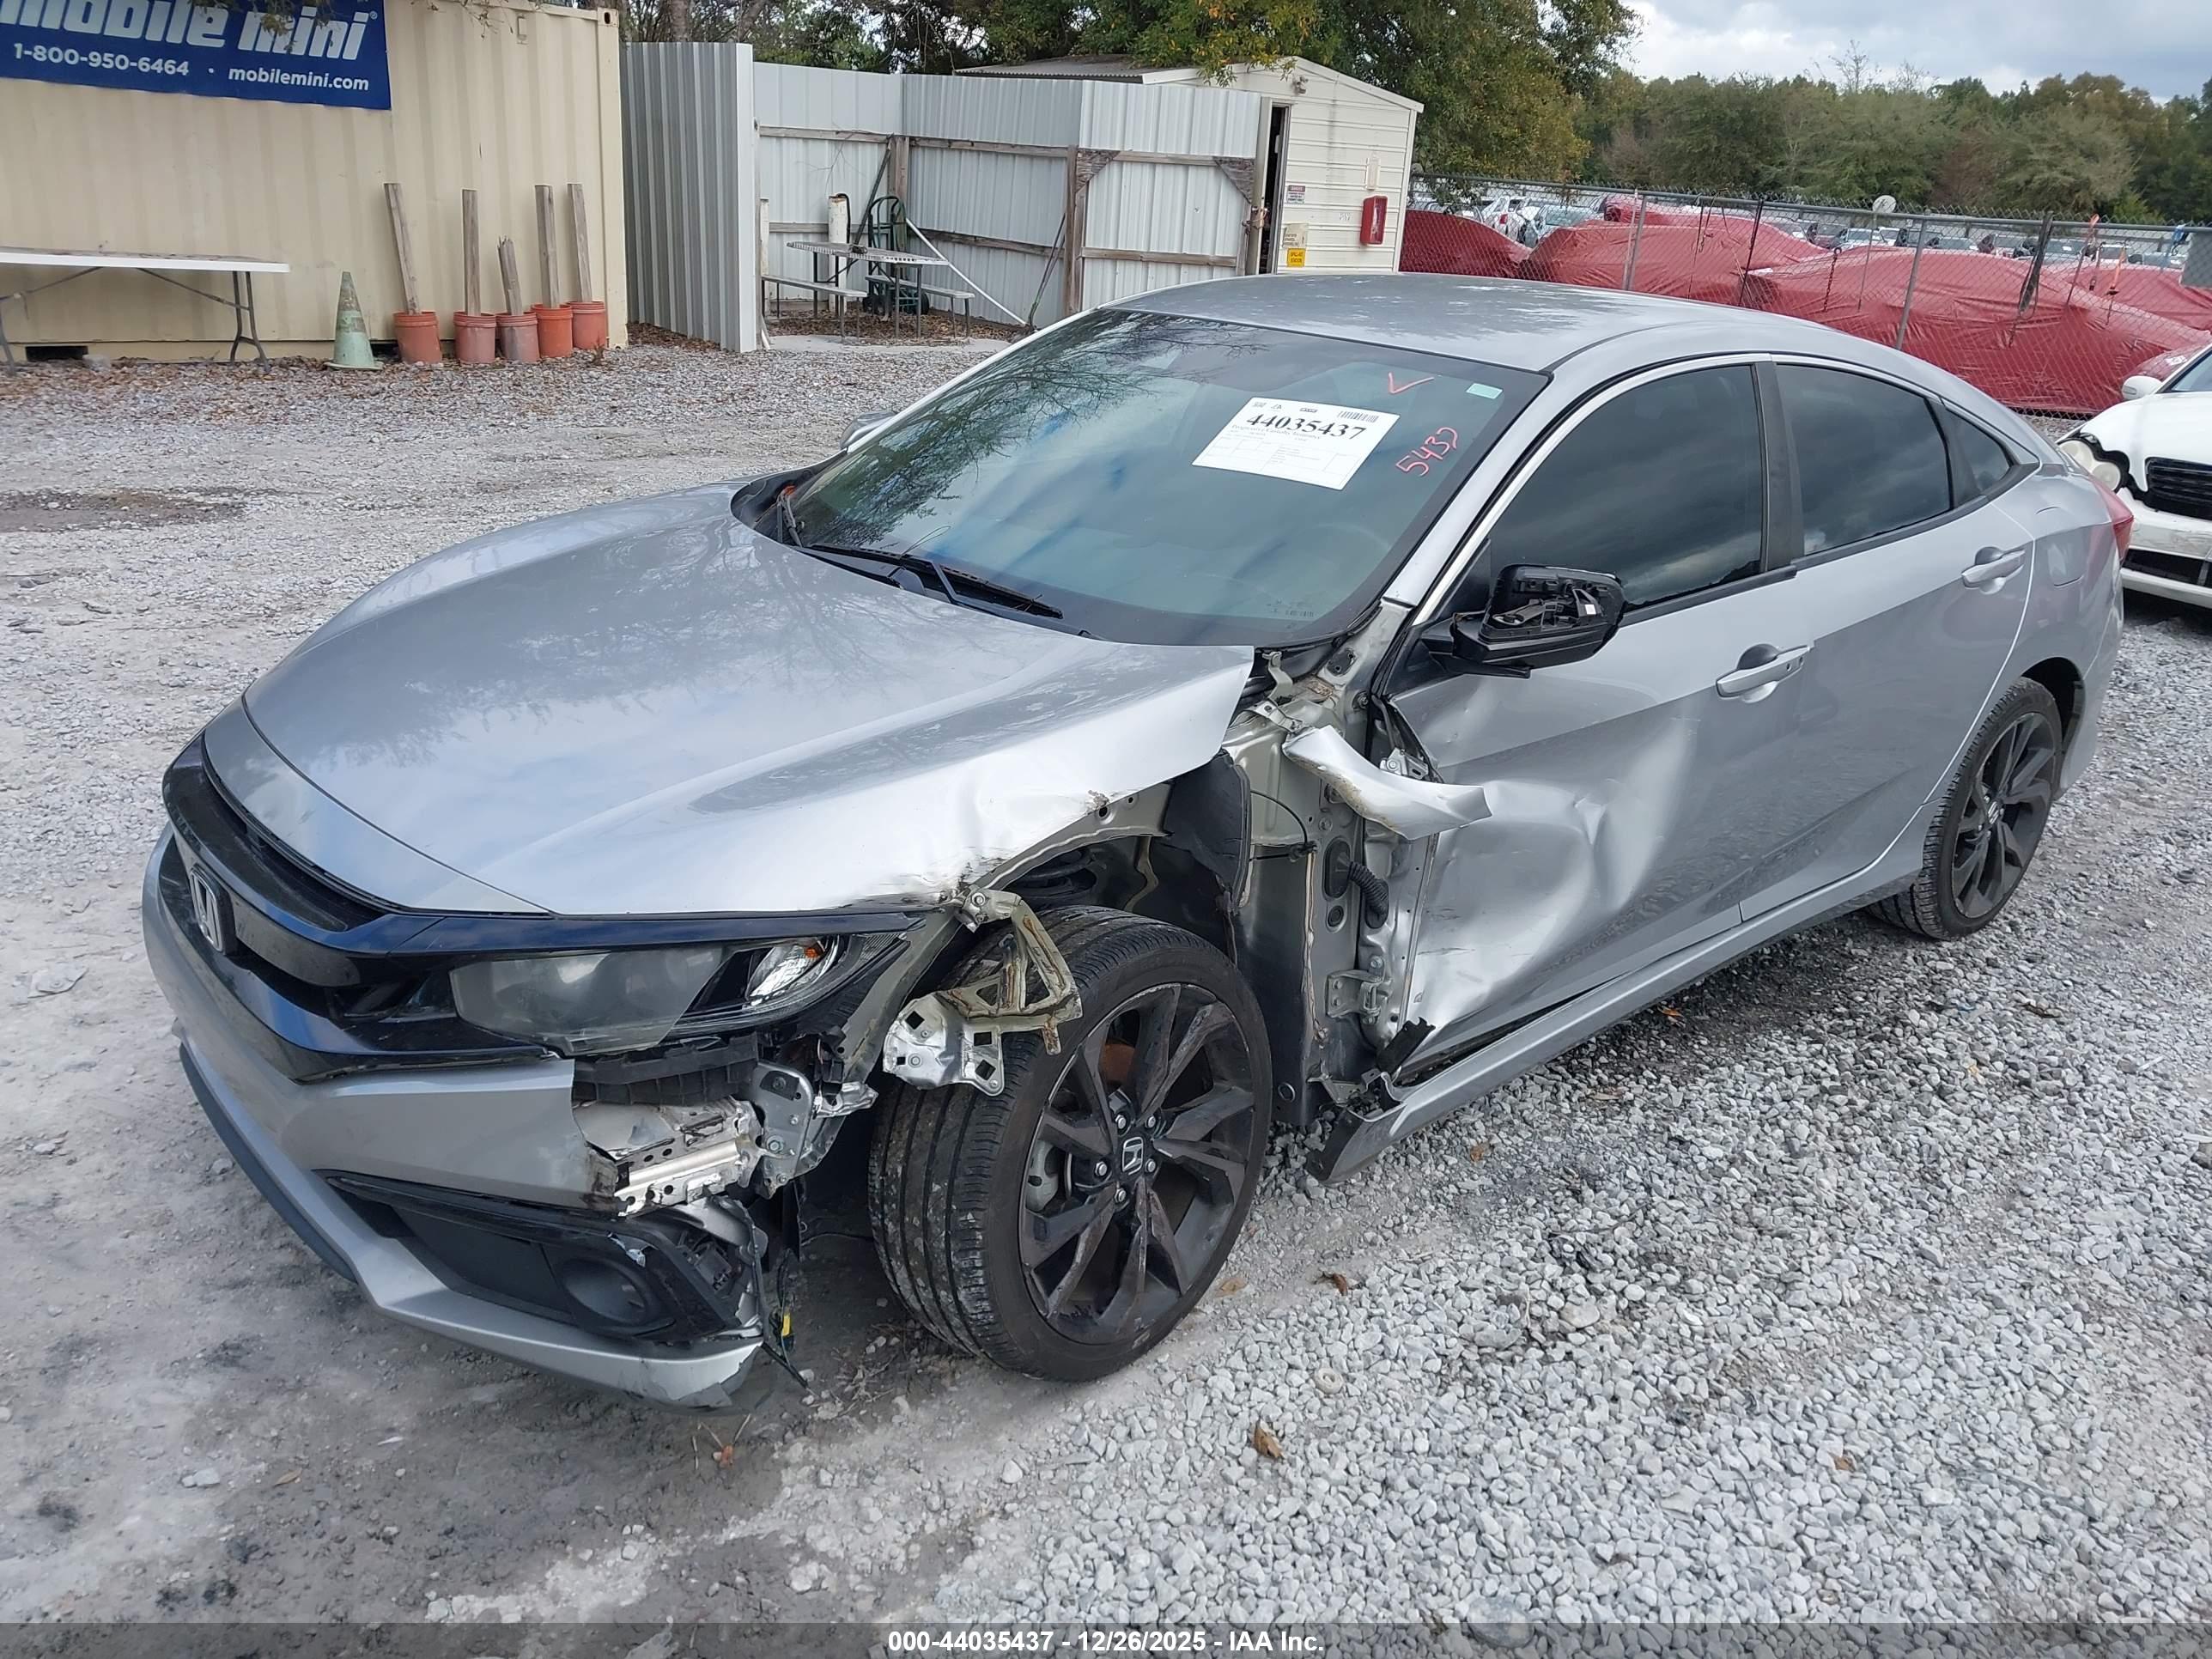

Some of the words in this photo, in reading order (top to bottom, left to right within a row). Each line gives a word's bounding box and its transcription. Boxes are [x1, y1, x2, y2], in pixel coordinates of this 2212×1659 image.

[0, 0, 229, 48] mobile
[237, 6, 369, 60] mini
[14, 43, 189, 76] 1-800-950-6464
[228, 67, 369, 91] mobilemini.com
[1247, 413, 1367, 440] 44035437
